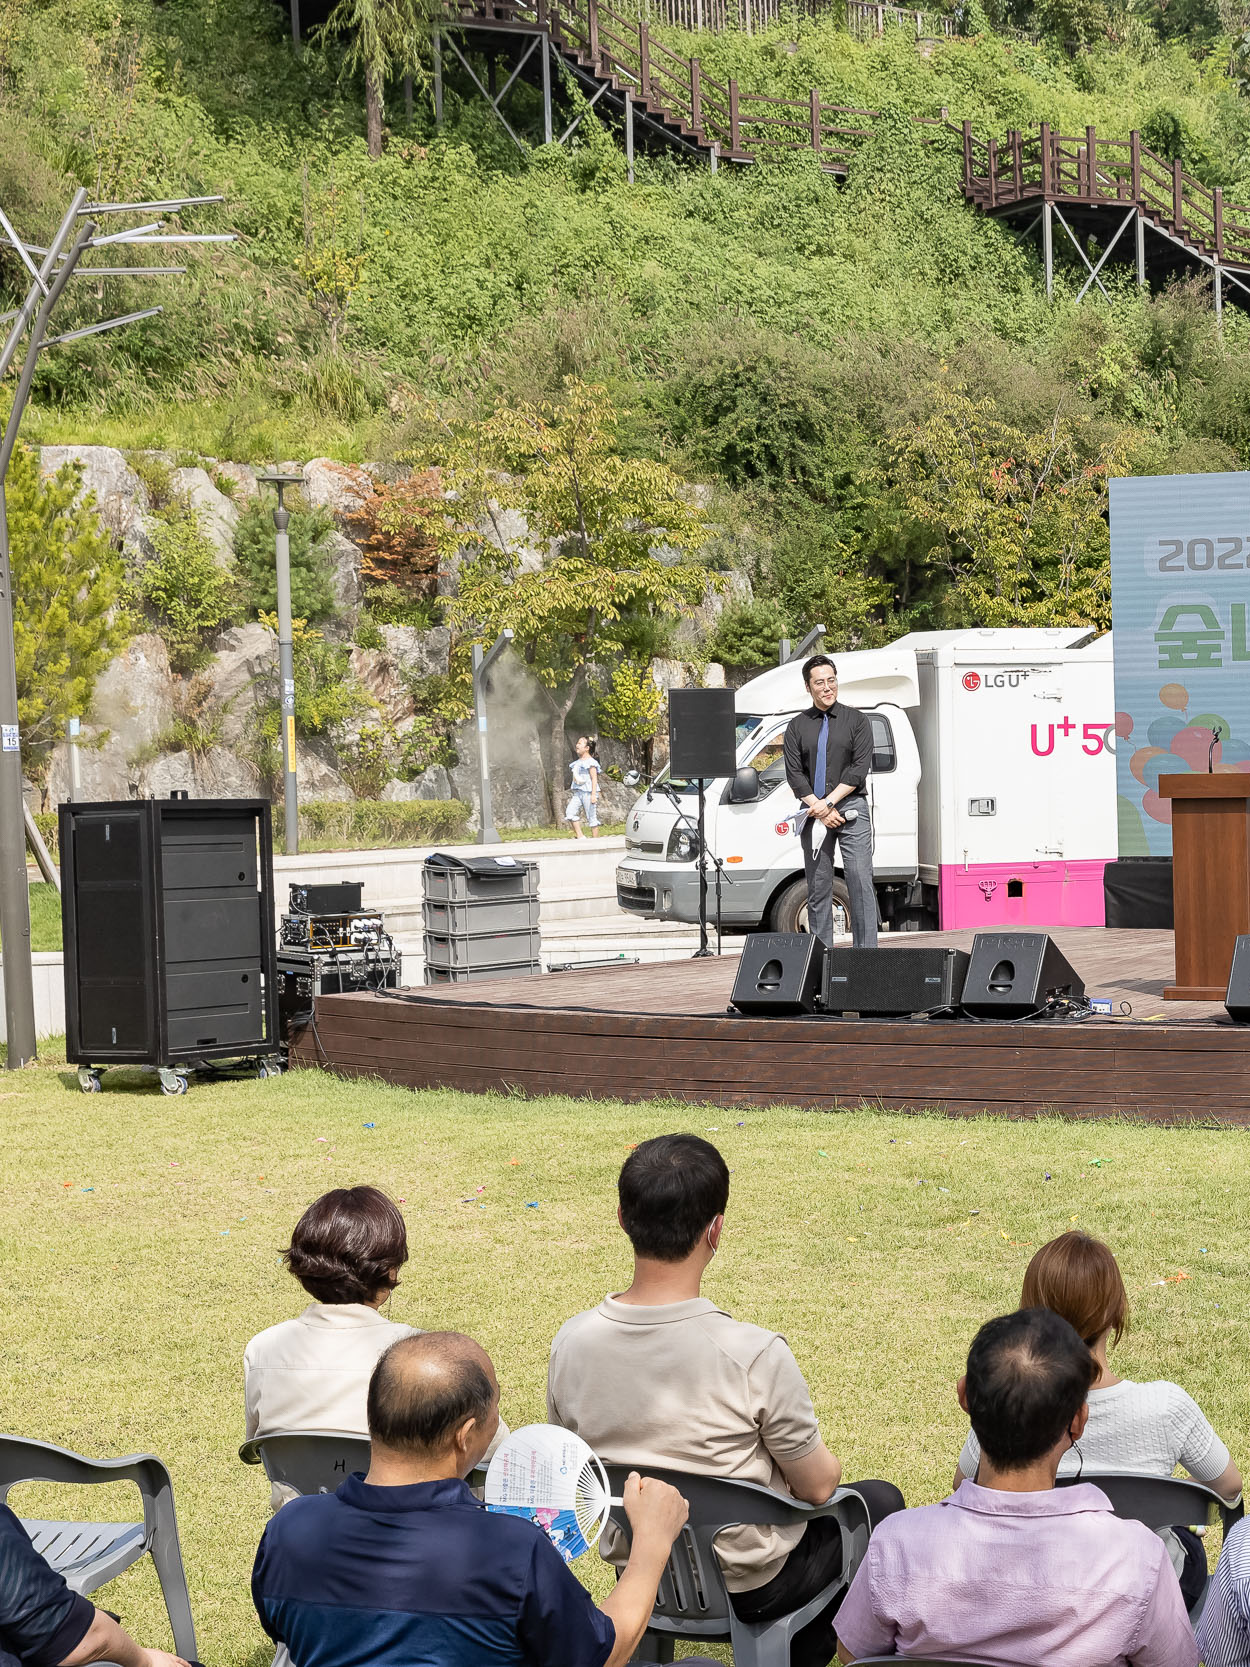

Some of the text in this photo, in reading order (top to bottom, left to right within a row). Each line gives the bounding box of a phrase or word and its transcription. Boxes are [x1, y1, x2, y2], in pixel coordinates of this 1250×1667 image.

[985, 674, 1005, 688] LG
[7, 737, 17, 746] 15
[334, 1459, 345, 1472] H
